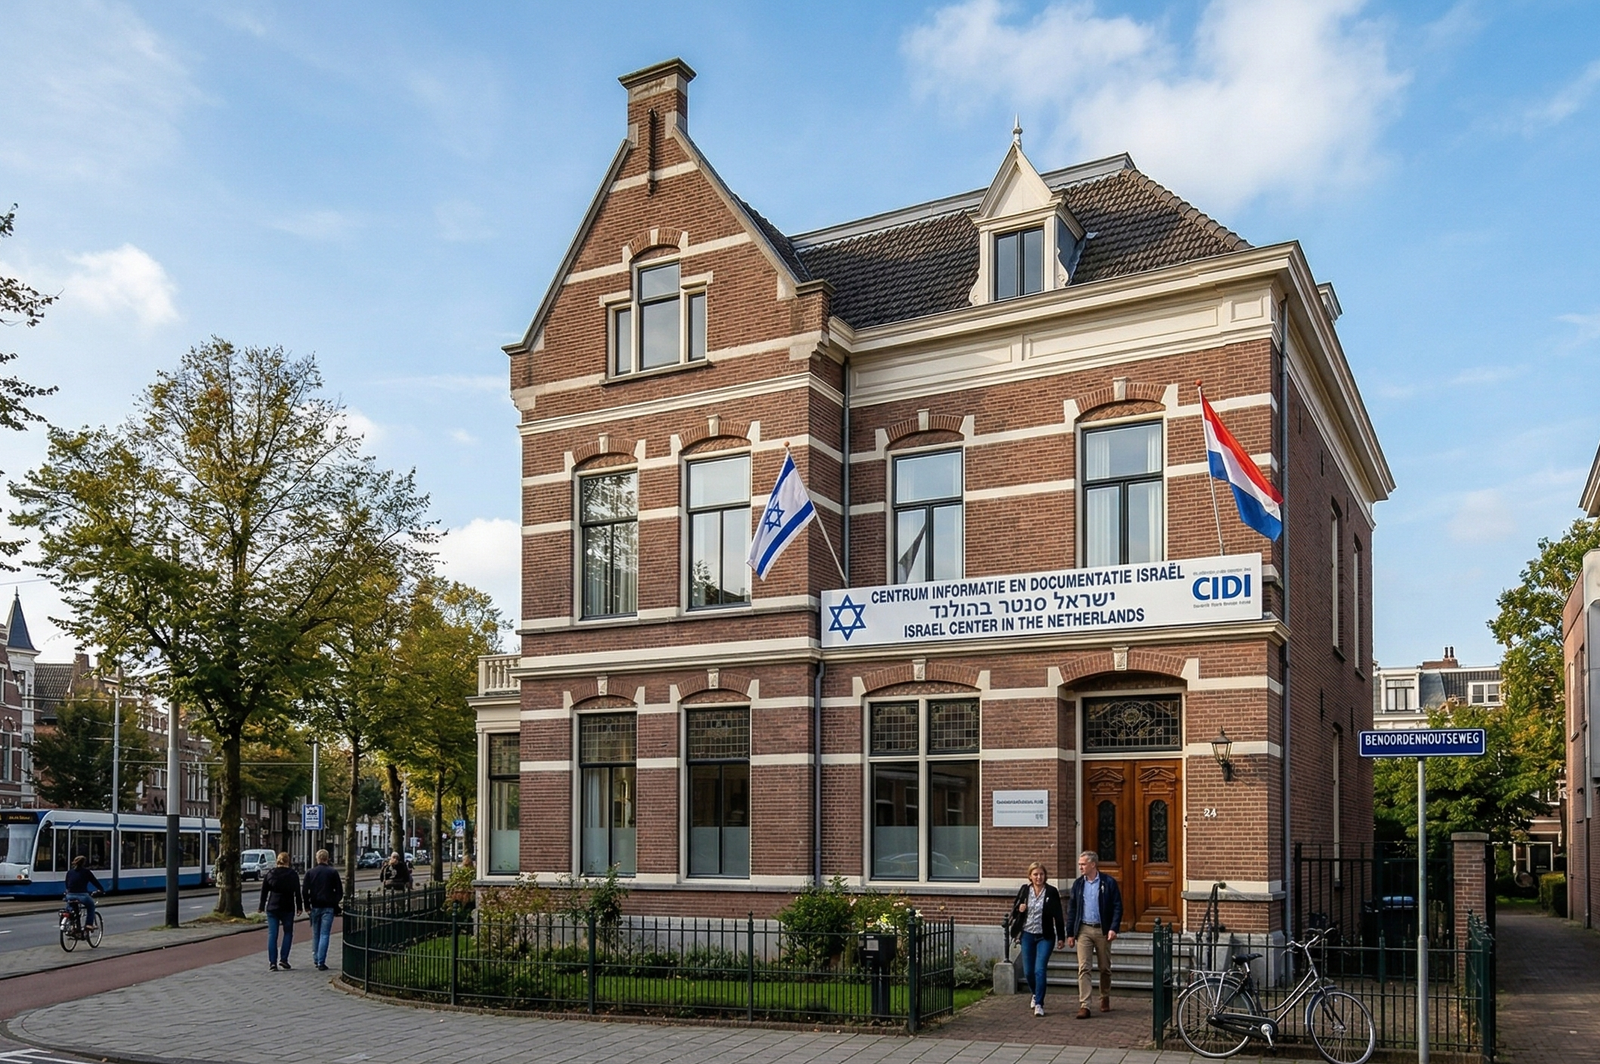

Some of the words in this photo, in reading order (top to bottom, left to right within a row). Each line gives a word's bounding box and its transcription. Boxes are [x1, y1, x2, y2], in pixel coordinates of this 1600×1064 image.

[871, 587, 929, 604] CENTRUM
[932, 580, 1006, 599] INFORMATIE
[1010, 578, 1026, 593] EN
[1031, 569, 1132, 592] DOCUMENTATIE
[1137, 562, 1185, 583] ISRAËL
[1192, 574, 1251, 601] CIDI
[929, 600, 993, 618] בהולנד
[999, 597, 1047, 614] סנטר
[1053, 592, 1116, 610] ישראל
[904, 622, 946, 638] ISRAEL
[949, 618, 998, 635] CENTER
[1001, 617, 1014, 631] IN
[1018, 615, 1043, 630] THE
[1047, 607, 1145, 629] NETHERLANDS
[1365, 732, 1480, 746] BENOORDENHOUTSEWEG
[1203, 807, 1217, 818] 24
